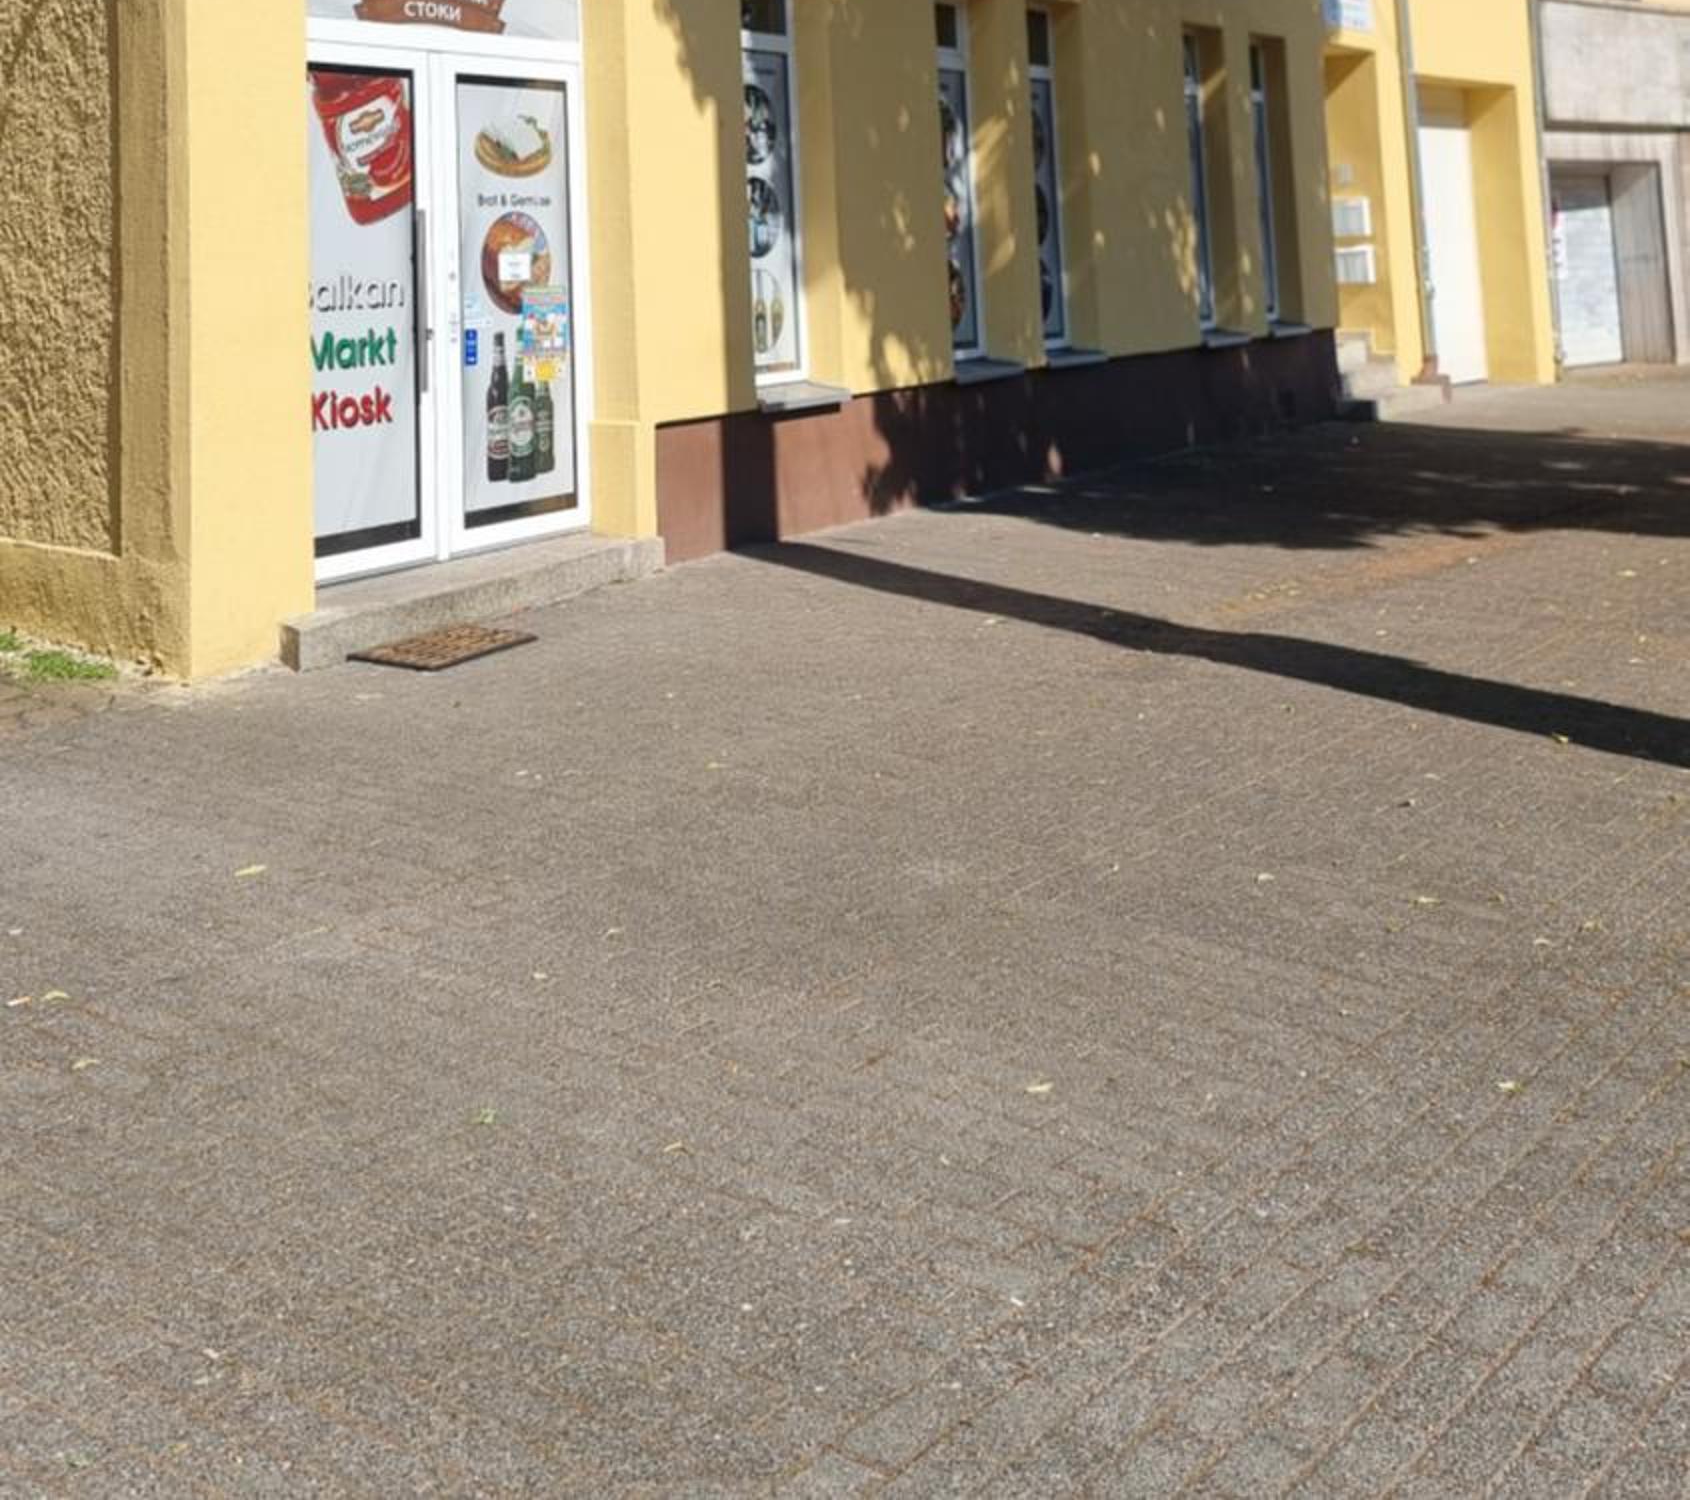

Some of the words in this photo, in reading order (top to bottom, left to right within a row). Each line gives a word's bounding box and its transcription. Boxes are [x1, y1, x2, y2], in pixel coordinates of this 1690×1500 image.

[403, 0, 463, 22] СТОКИ
[308, 275, 405, 313] alkan
[311, 384, 393, 432] Kiosk
